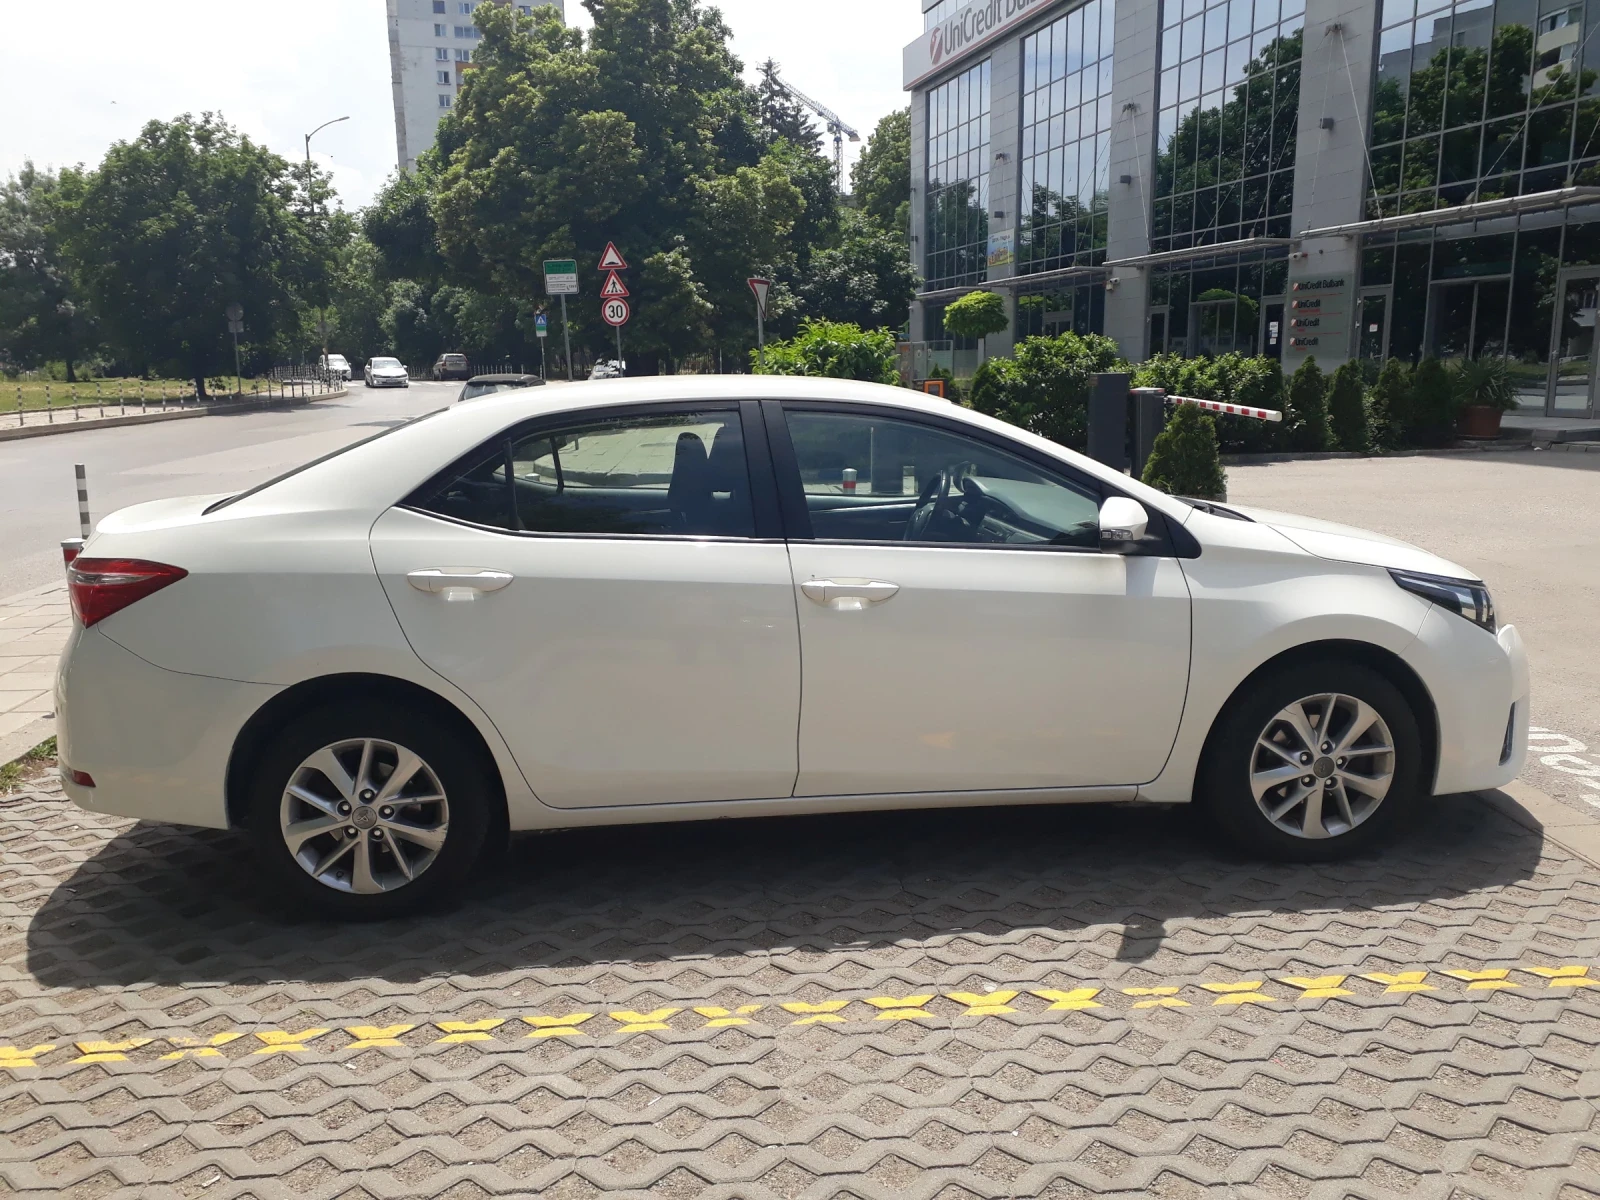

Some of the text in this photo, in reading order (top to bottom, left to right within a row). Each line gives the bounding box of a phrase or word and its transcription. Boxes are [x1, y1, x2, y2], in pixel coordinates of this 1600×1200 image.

[944, 0, 1002, 55] UniCredit
[1299, 279, 1344, 290] UniCredit Bulbank
[1298, 299, 1320, 308] UniCredit
[608, 304, 624, 318] 30
[1296, 318, 1320, 327] UniCredit
[1295, 337, 1319, 346] UniCredit
